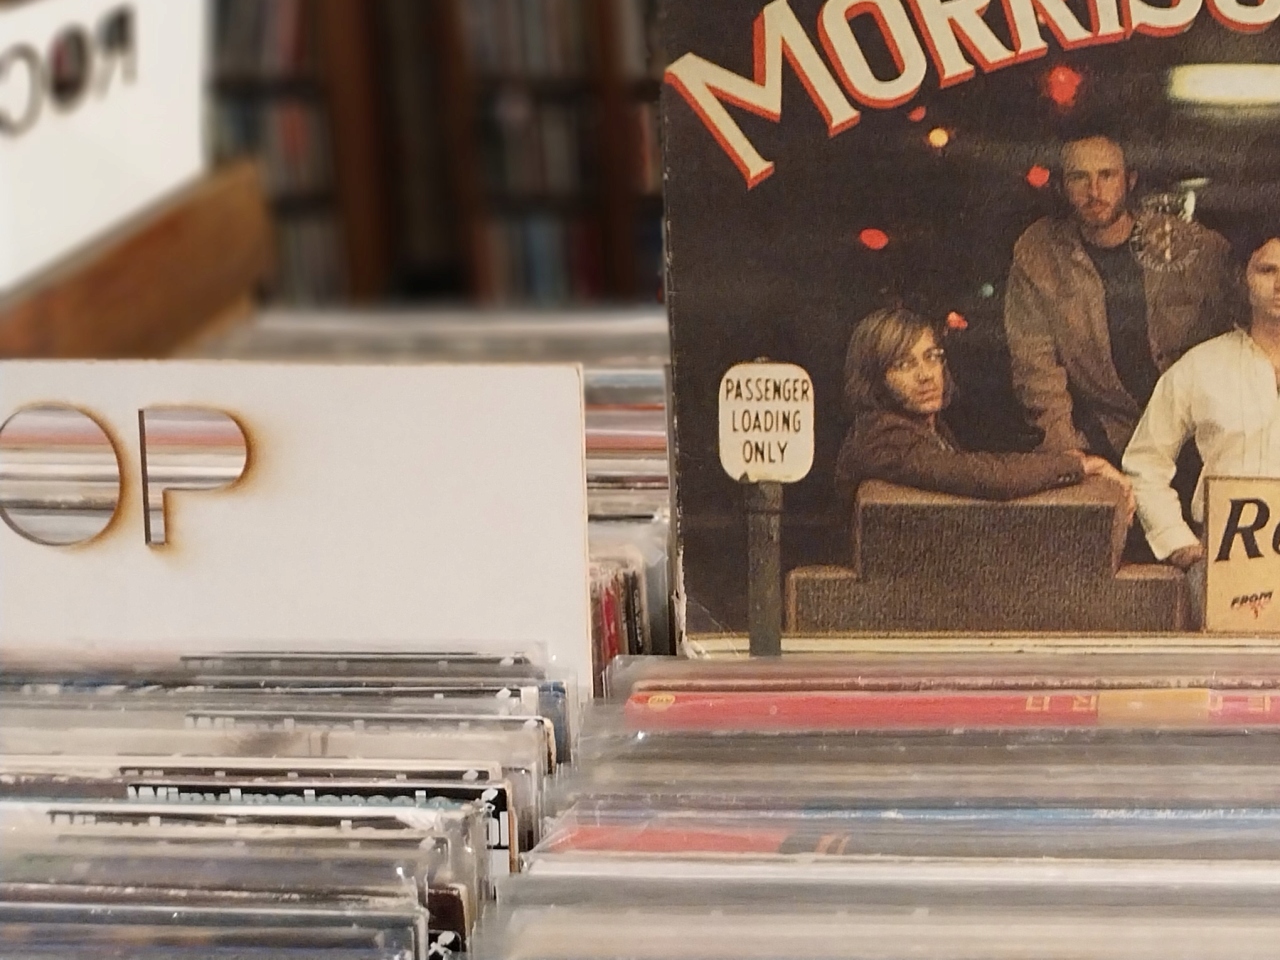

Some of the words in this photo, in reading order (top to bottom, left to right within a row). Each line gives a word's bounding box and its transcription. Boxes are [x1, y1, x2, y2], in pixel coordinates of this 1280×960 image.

[725, 378, 810, 402] PASSENGER
[732, 409, 802, 433] LOADING
[742, 440, 788, 464] ONLY
